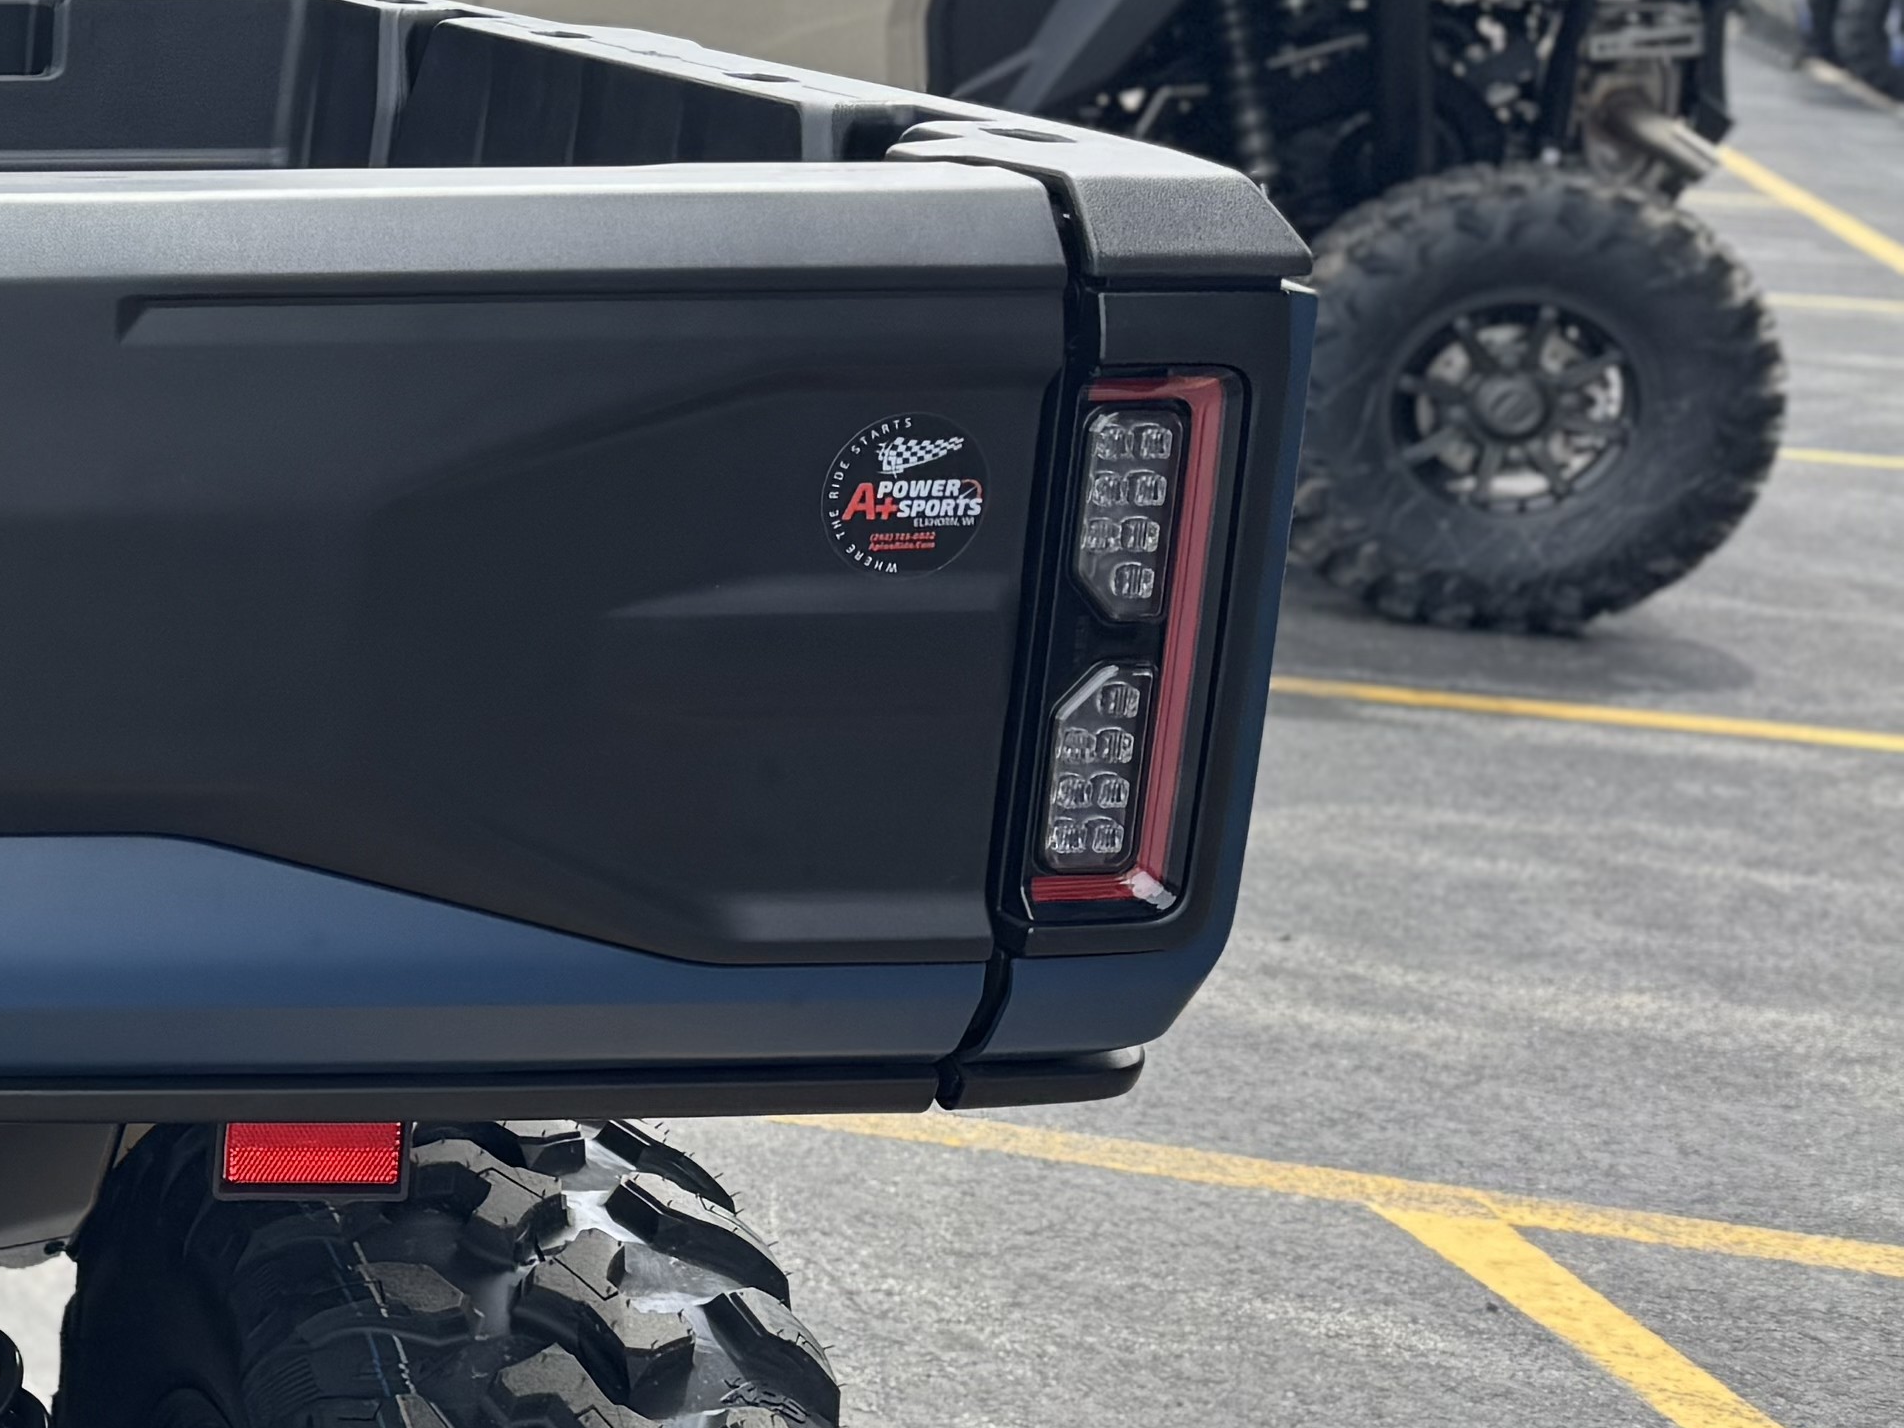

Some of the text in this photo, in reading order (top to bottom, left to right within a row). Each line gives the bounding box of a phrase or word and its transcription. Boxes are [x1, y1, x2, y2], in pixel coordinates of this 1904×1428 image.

[828, 417, 912, 573] WHERE THE RIDE STARTS
[842, 482, 899, 521] A+
[876, 479, 962, 499] POWER
[896, 498, 984, 518] SPORTS
